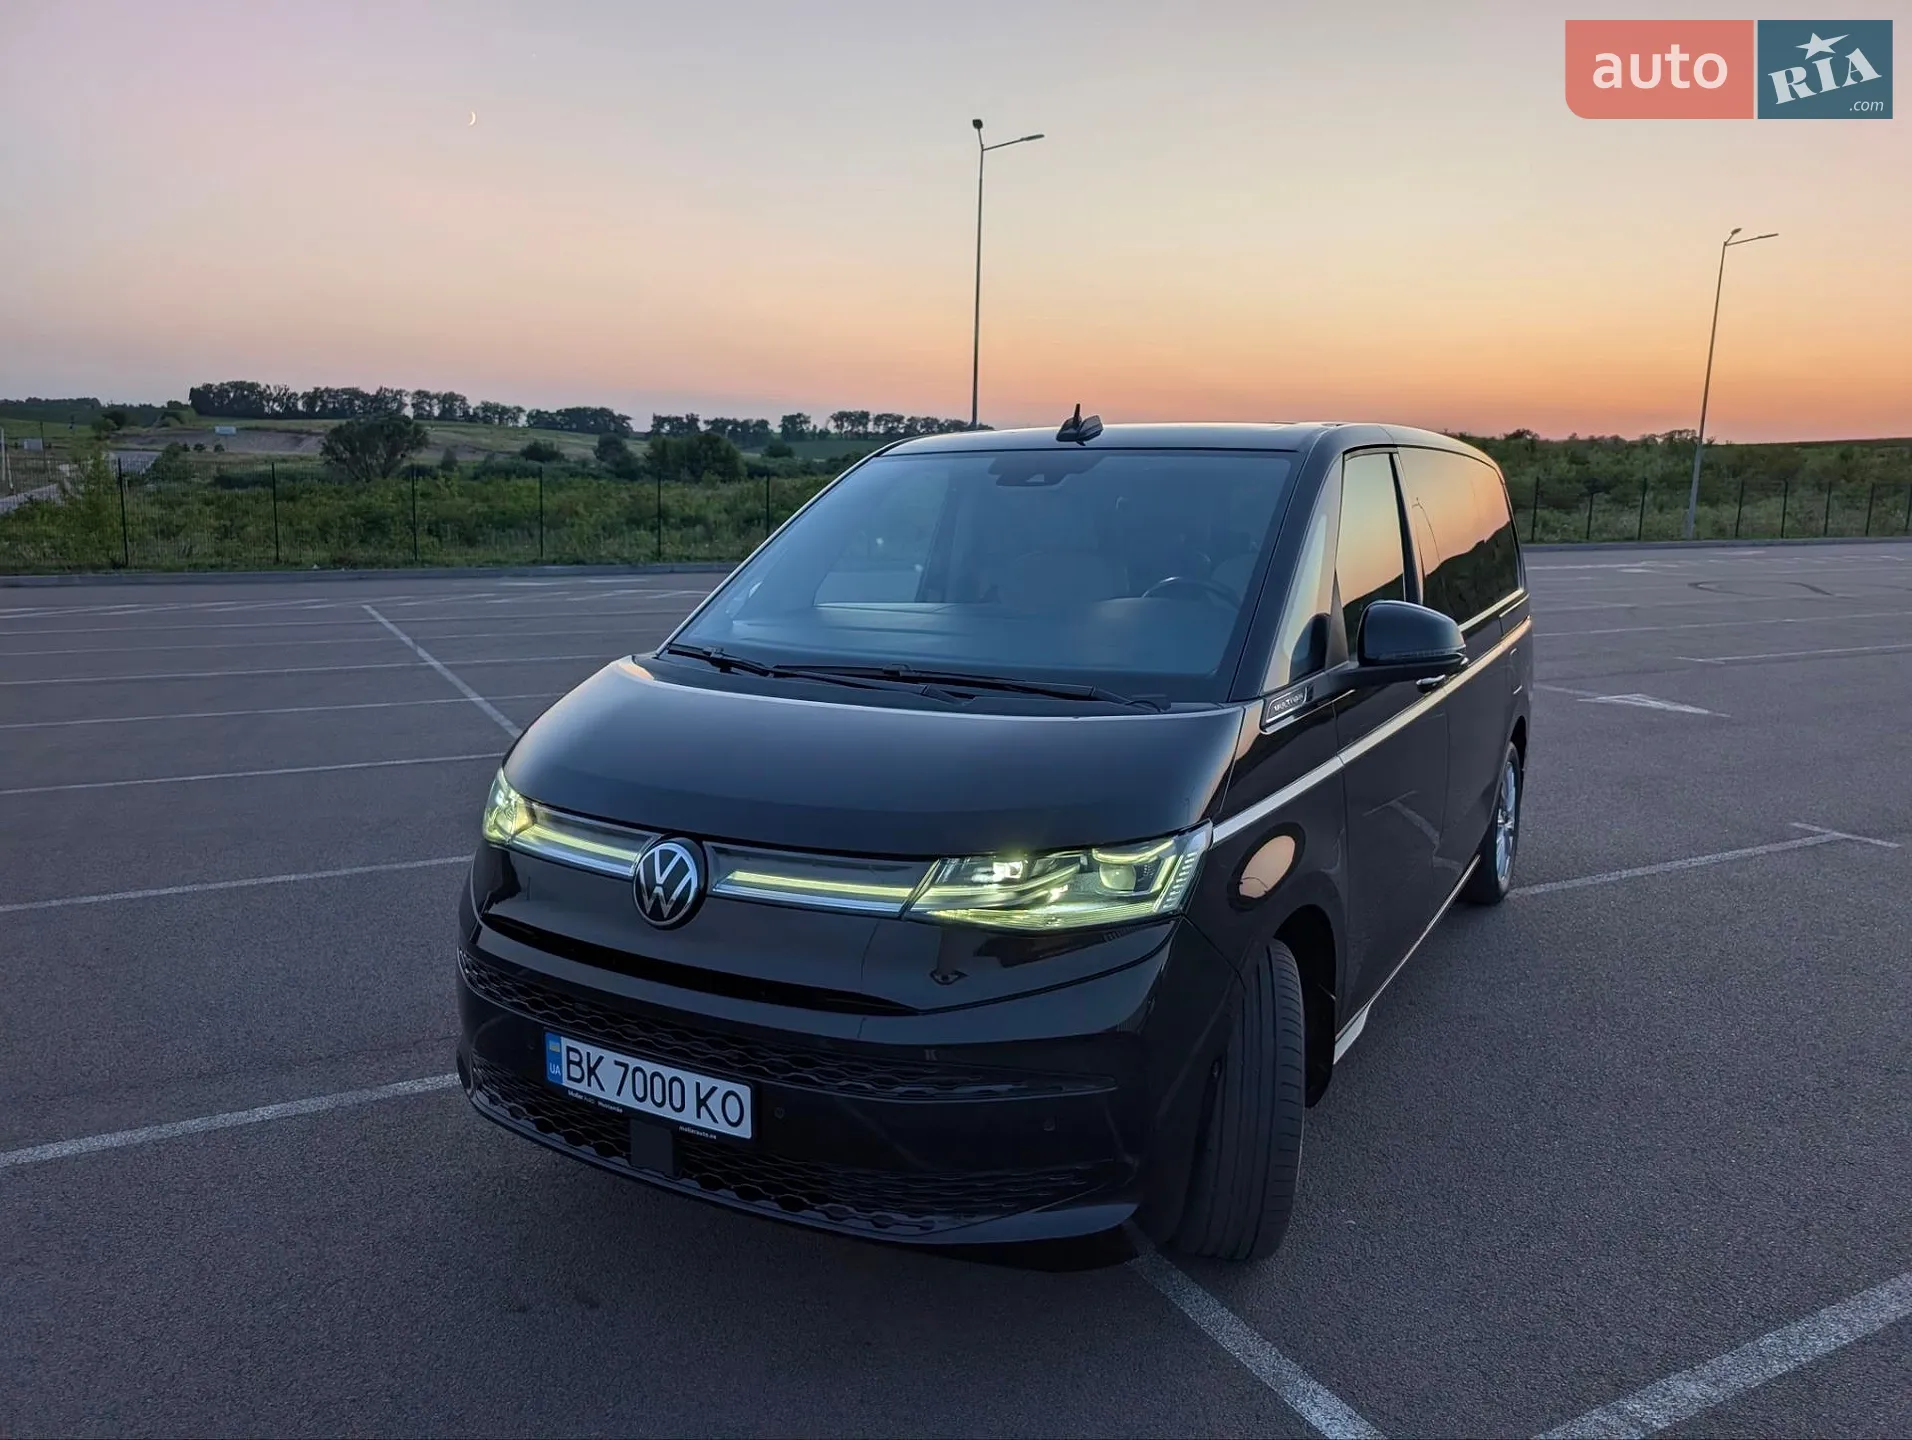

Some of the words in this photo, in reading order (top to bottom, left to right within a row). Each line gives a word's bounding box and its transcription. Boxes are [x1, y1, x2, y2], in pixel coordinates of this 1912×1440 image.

[550, 1062, 561, 1076] UA
[565, 1045, 606, 1092] BK
[614, 1060, 686, 1113] 7000
[695, 1081, 745, 1128] KO
